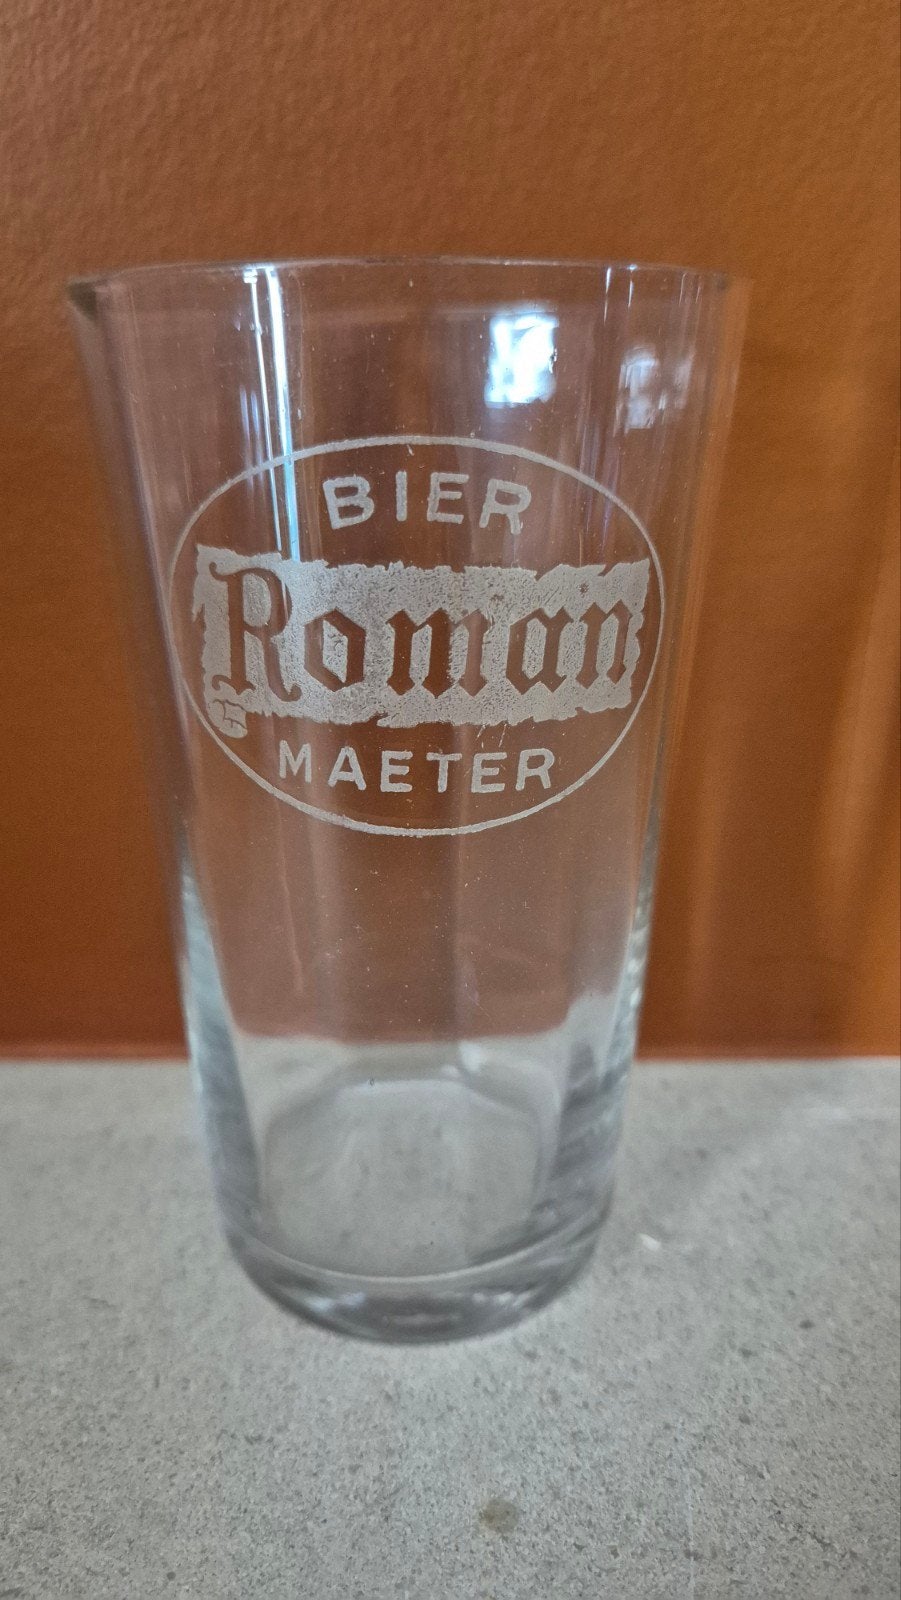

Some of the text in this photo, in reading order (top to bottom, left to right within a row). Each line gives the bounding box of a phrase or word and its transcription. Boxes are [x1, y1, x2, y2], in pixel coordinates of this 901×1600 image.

[323, 471, 532, 535] BIER
[209, 564, 632, 703] Roman
[278, 740, 556, 794] MAETER
